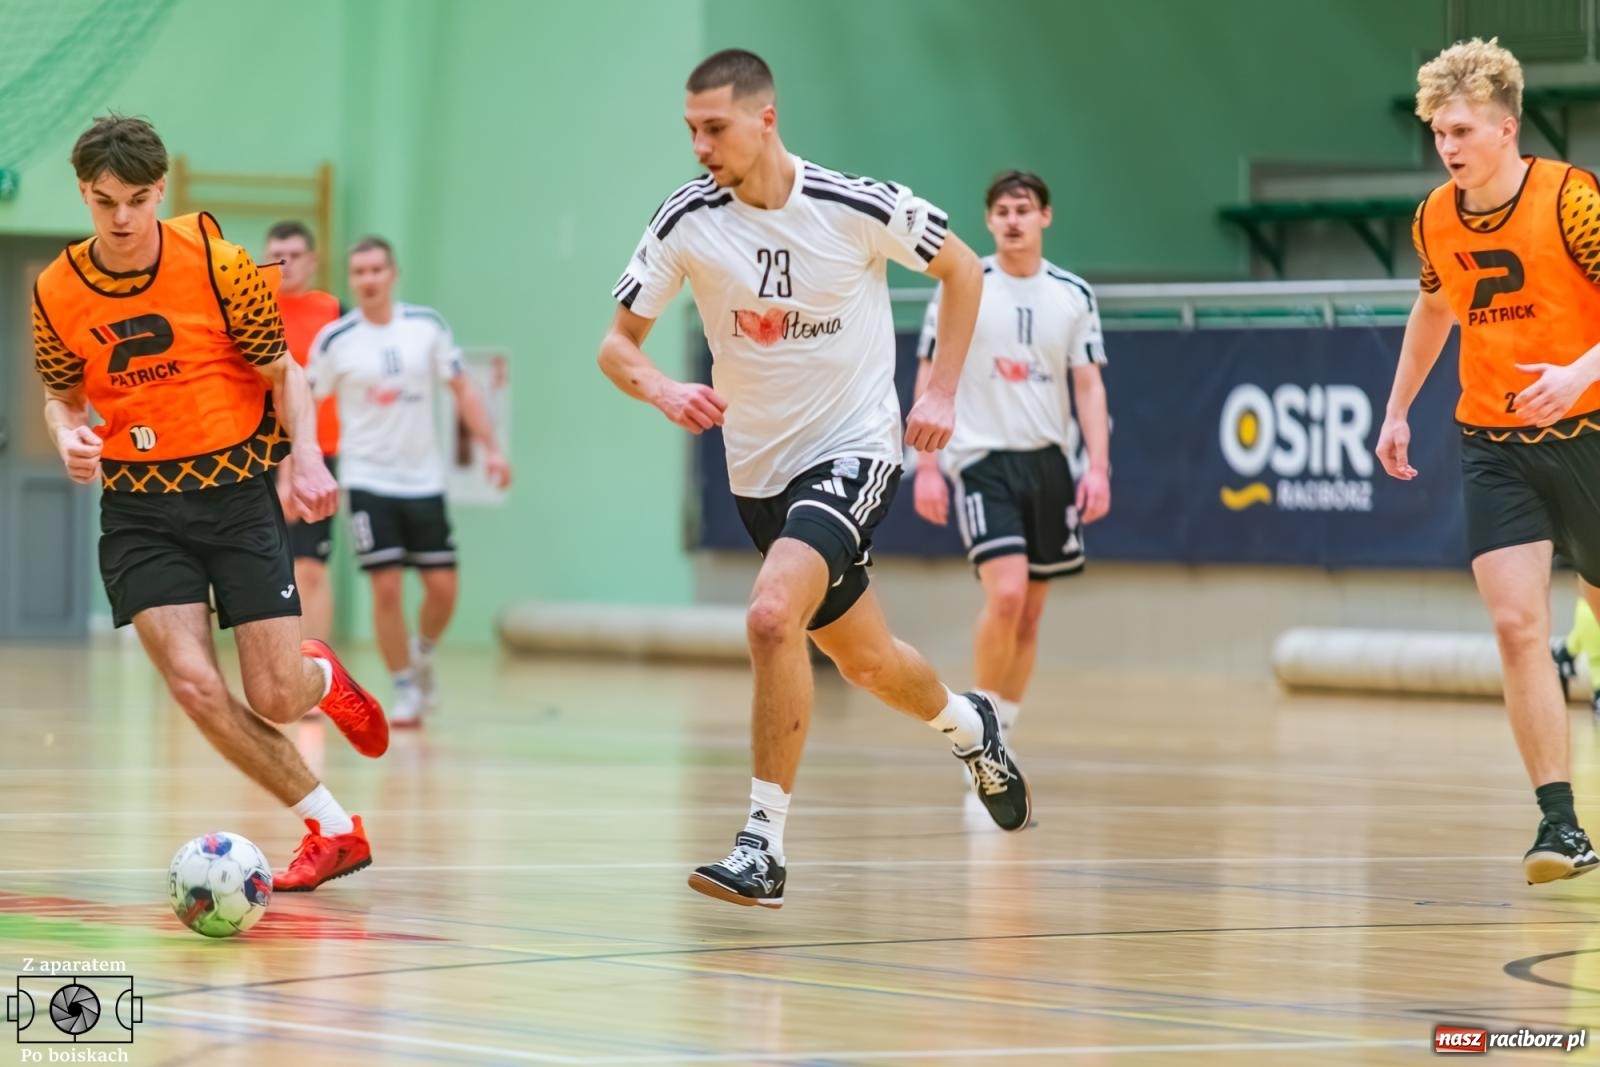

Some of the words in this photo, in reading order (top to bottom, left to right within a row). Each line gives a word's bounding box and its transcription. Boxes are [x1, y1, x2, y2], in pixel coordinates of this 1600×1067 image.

[757, 248, 792, 298] 23
[1015, 306, 1033, 345] 11
[1468, 303, 1536, 326] PATRICK
[109, 360, 182, 387] PATRICK
[129, 426, 157, 451] 10
[1219, 383, 1374, 478] OSiR
